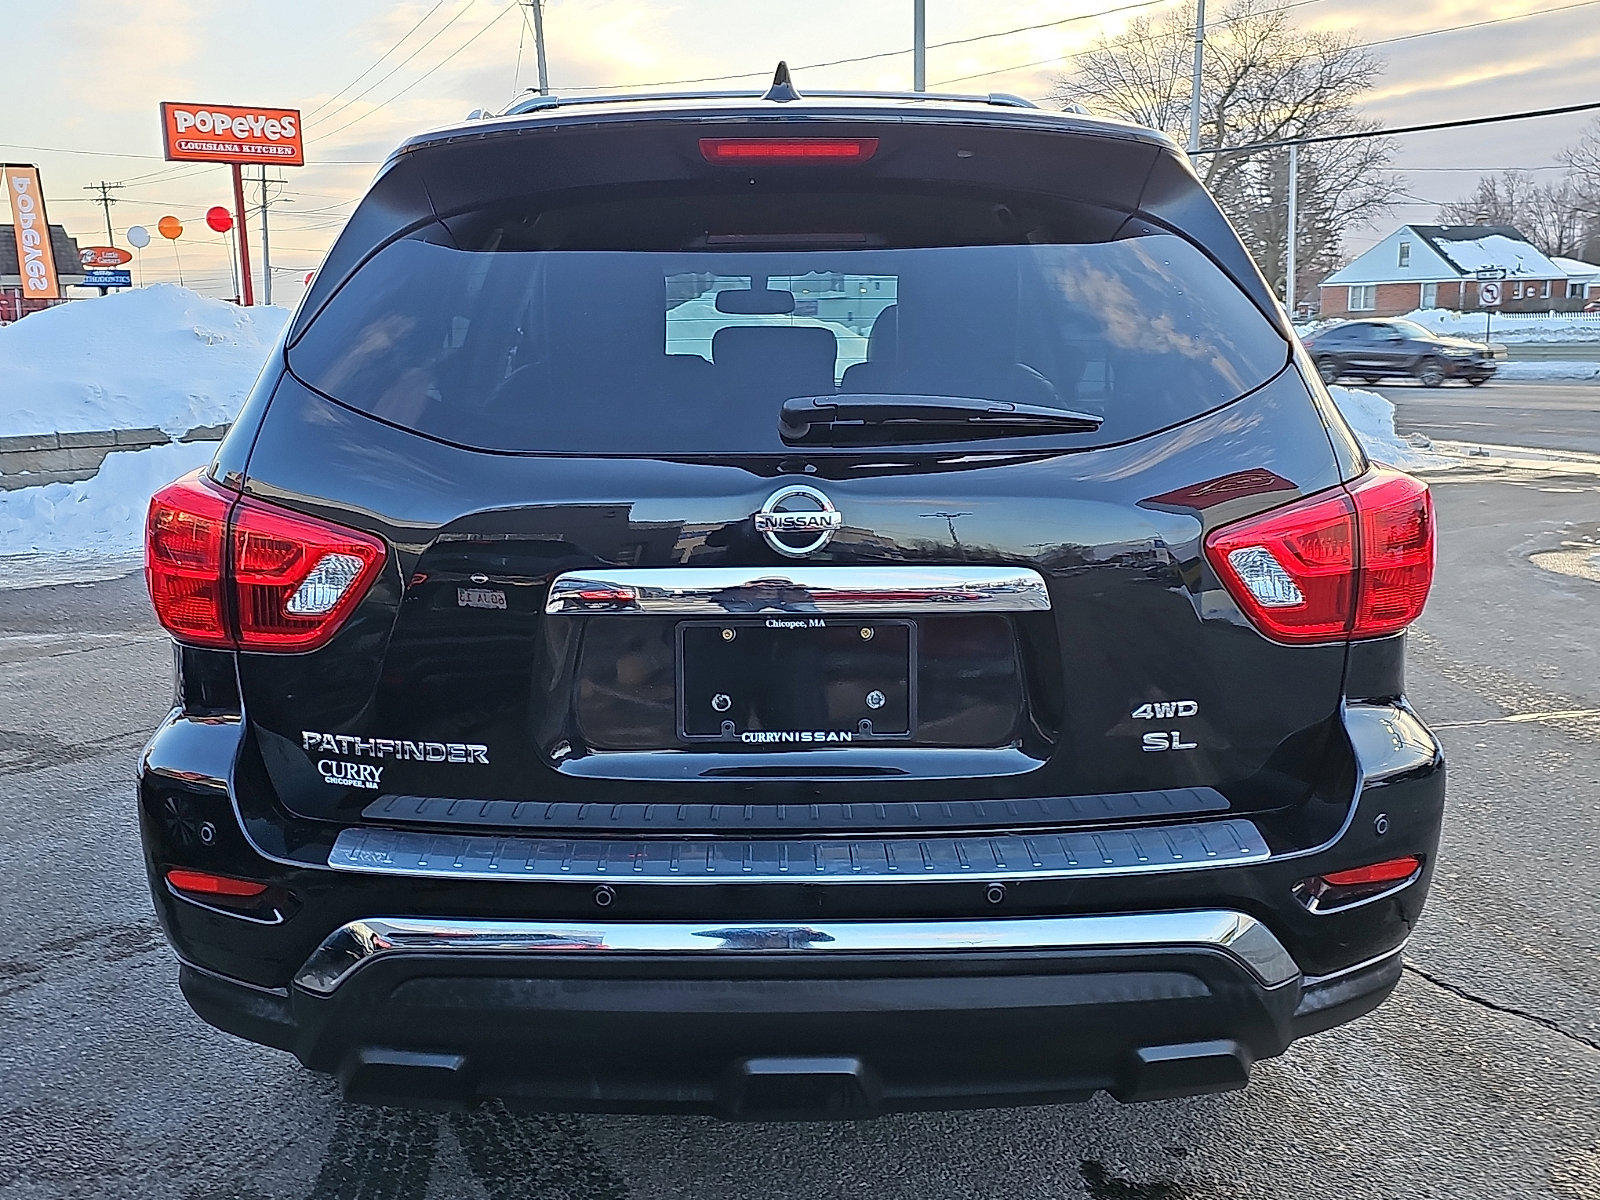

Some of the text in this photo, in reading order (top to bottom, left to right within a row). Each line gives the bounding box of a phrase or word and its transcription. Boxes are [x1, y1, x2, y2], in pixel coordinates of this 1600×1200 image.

[180, 141, 293, 155] LOUISIANA KITCHEN
[765, 516, 832, 528] NISSAN
[765, 619, 826, 630] Chicopee, MA
[1131, 700, 1198, 719] 4WD
[301, 730, 490, 764] PATHFINDER
[1142, 731, 1198, 752] SL
[317, 759, 384, 783] CURRY
[324, 777, 379, 790] CHICOPEE, MA
